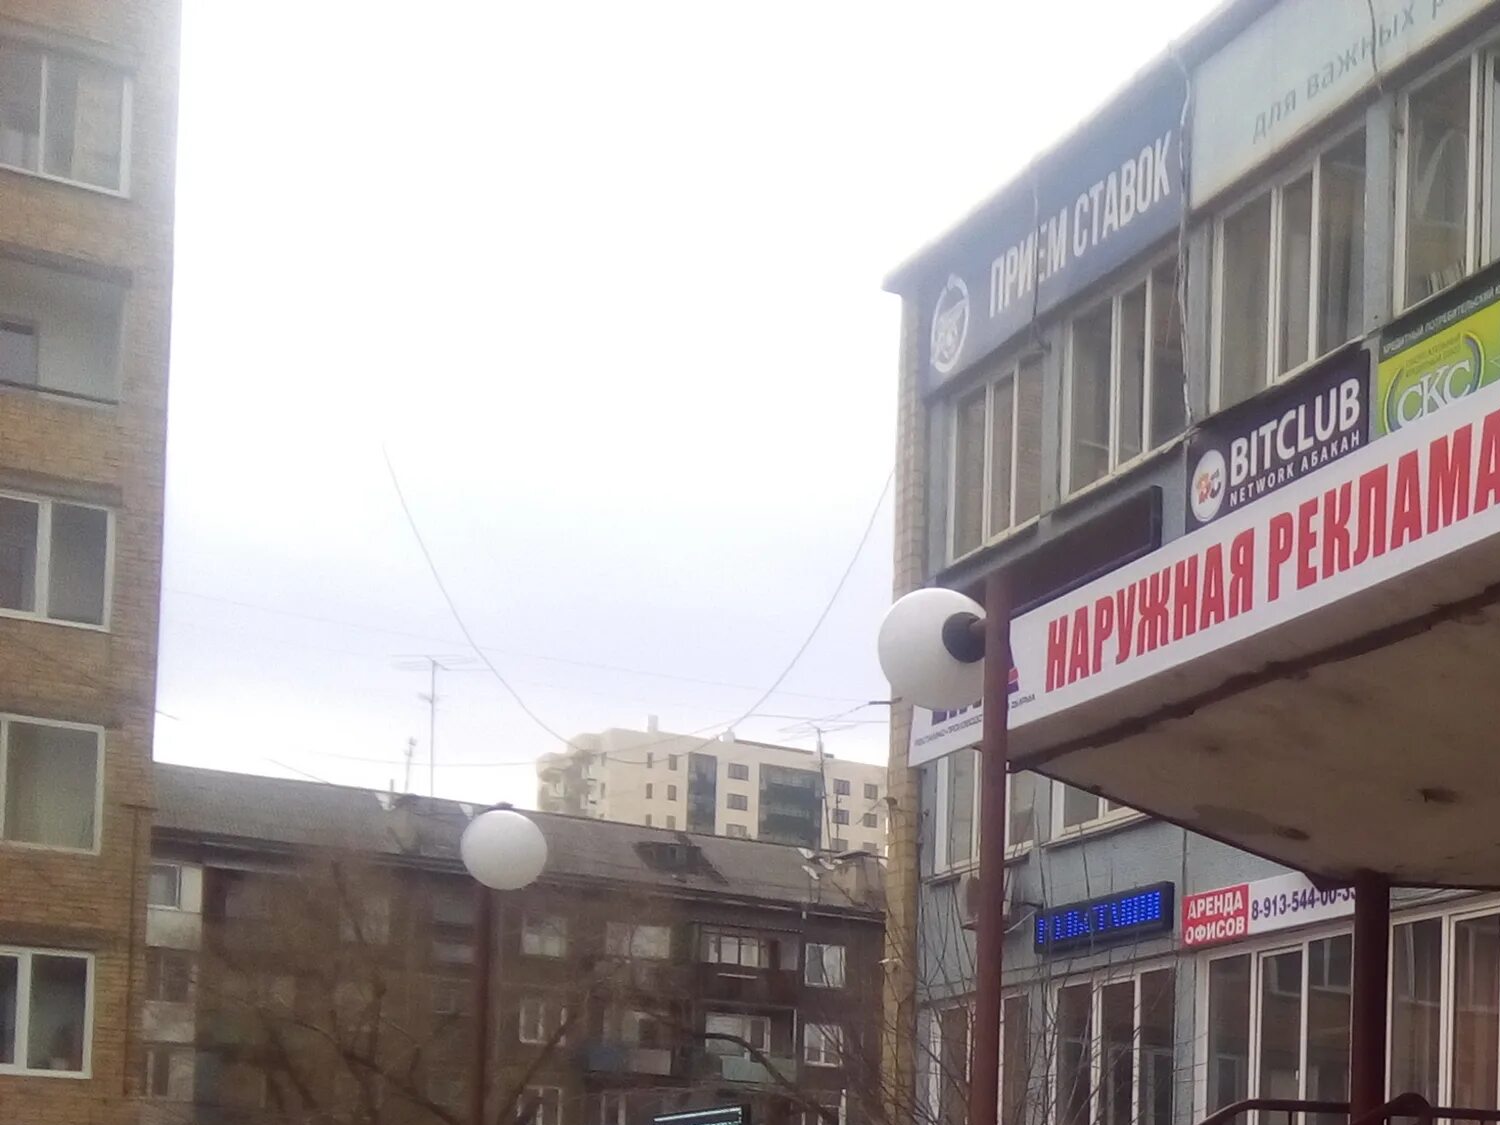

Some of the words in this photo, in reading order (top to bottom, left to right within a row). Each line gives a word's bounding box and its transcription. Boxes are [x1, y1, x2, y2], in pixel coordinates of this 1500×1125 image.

[1252, 88, 1297, 145] для
[1072, 129, 1173, 258] СТАВОК
[1396, 359, 1472, 429] СКС
[1230, 377, 1361, 488] BITCLUB
[1300, 429, 1361, 473] АБАКАН
[1229, 462, 1295, 508] NETWORK
[1045, 527, 1255, 693] НАРУЖНАЯ
[1184, 917, 1245, 946] ОФИСОВ
[1187, 889, 1244, 919] АРЕНДА
